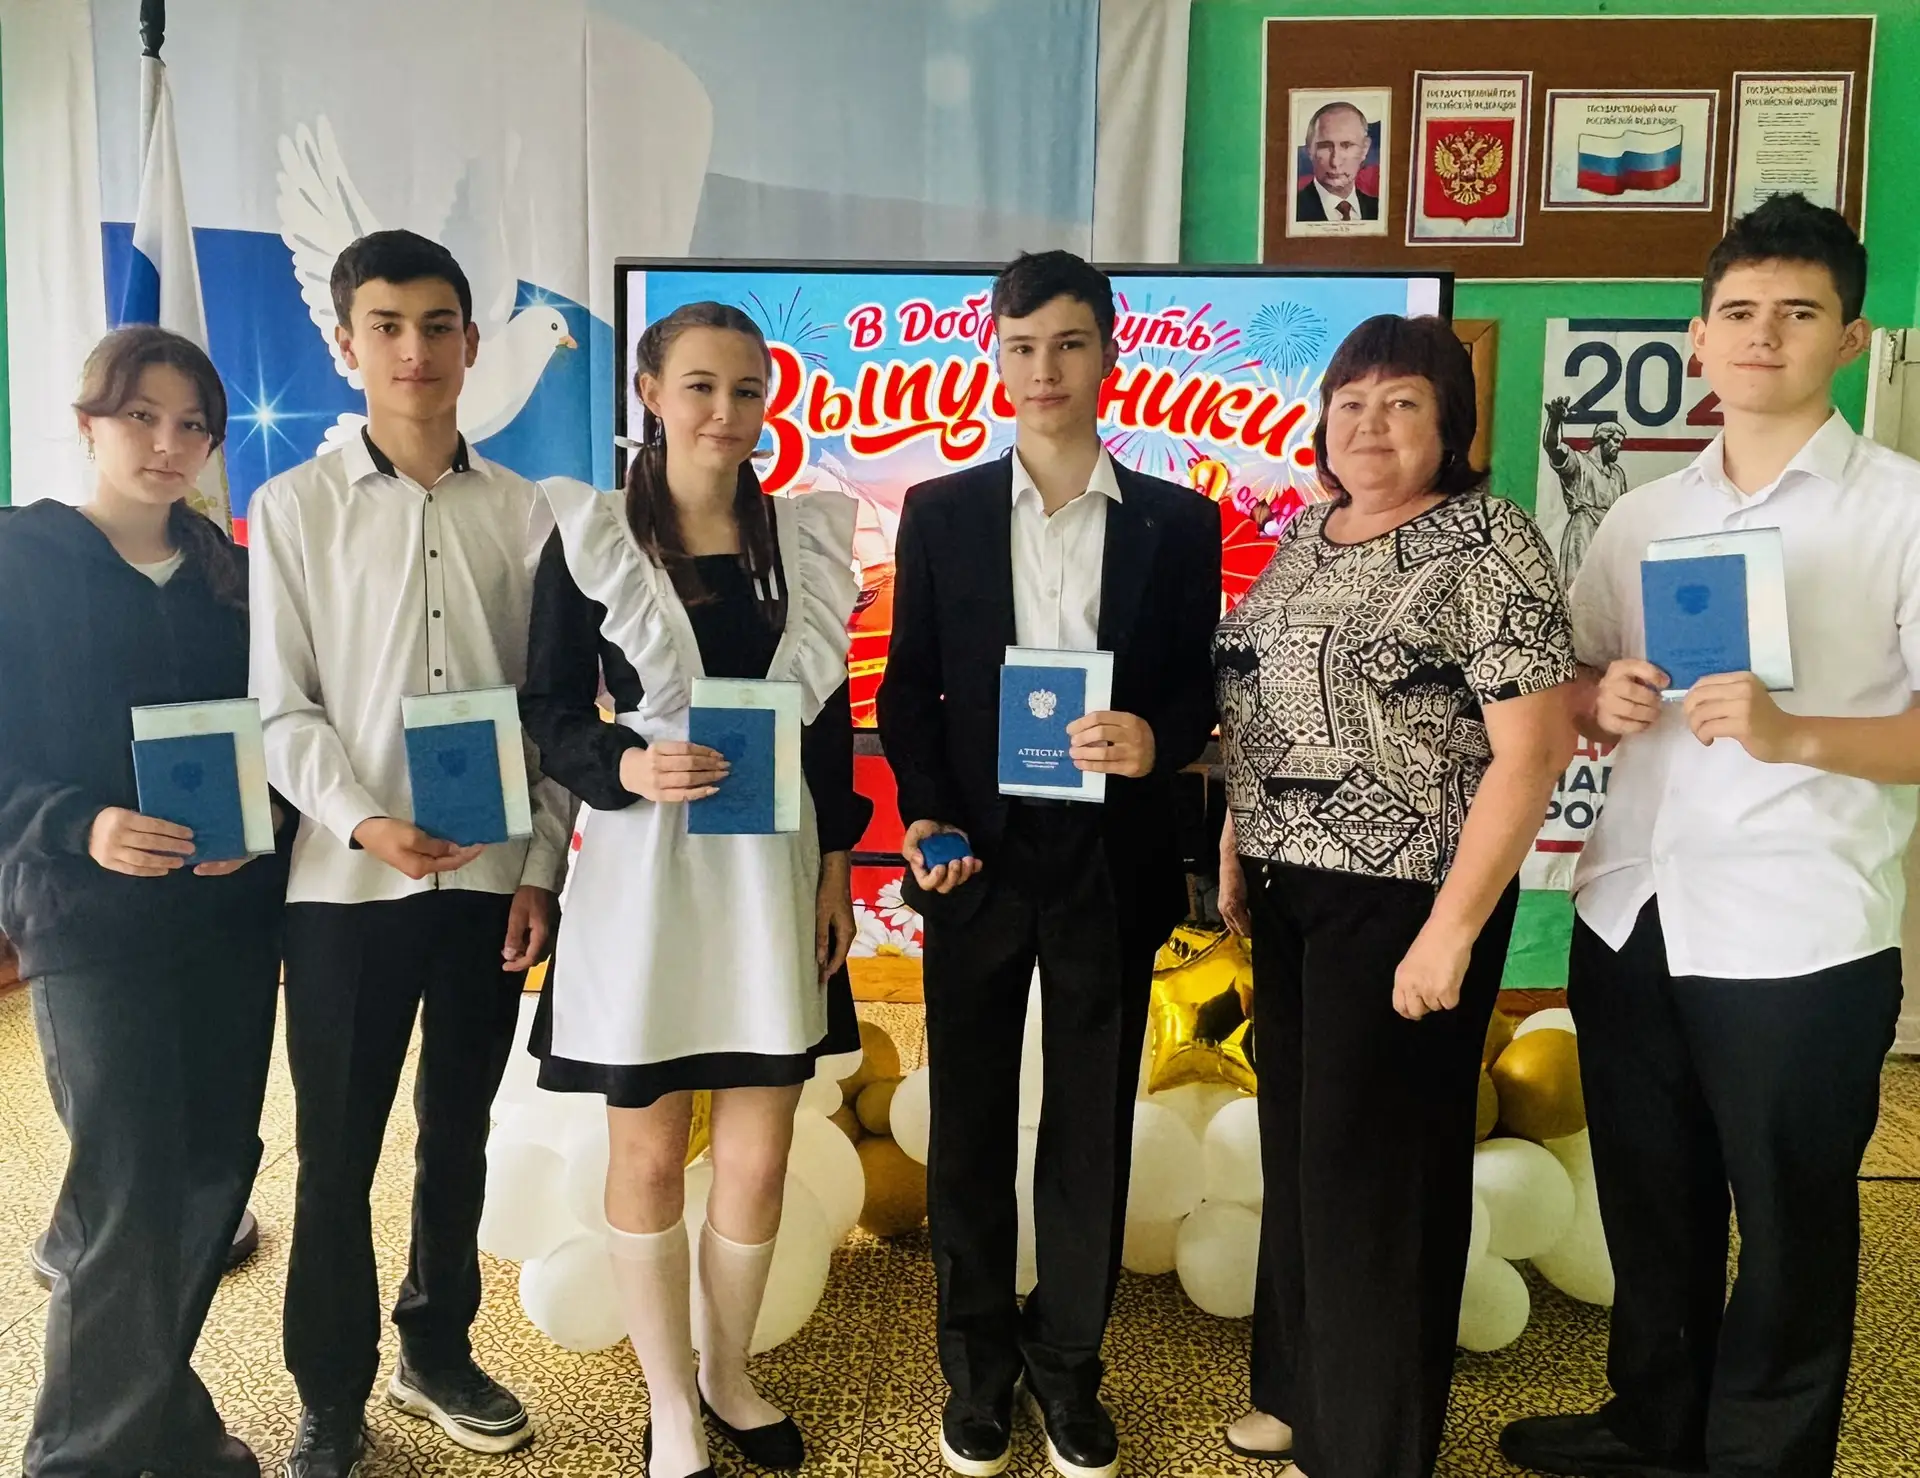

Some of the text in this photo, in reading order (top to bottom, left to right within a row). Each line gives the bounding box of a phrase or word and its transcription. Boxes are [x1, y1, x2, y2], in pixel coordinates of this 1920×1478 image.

[848, 294, 1213, 354] В Добр уть
[1564, 341, 1725, 427] 202
